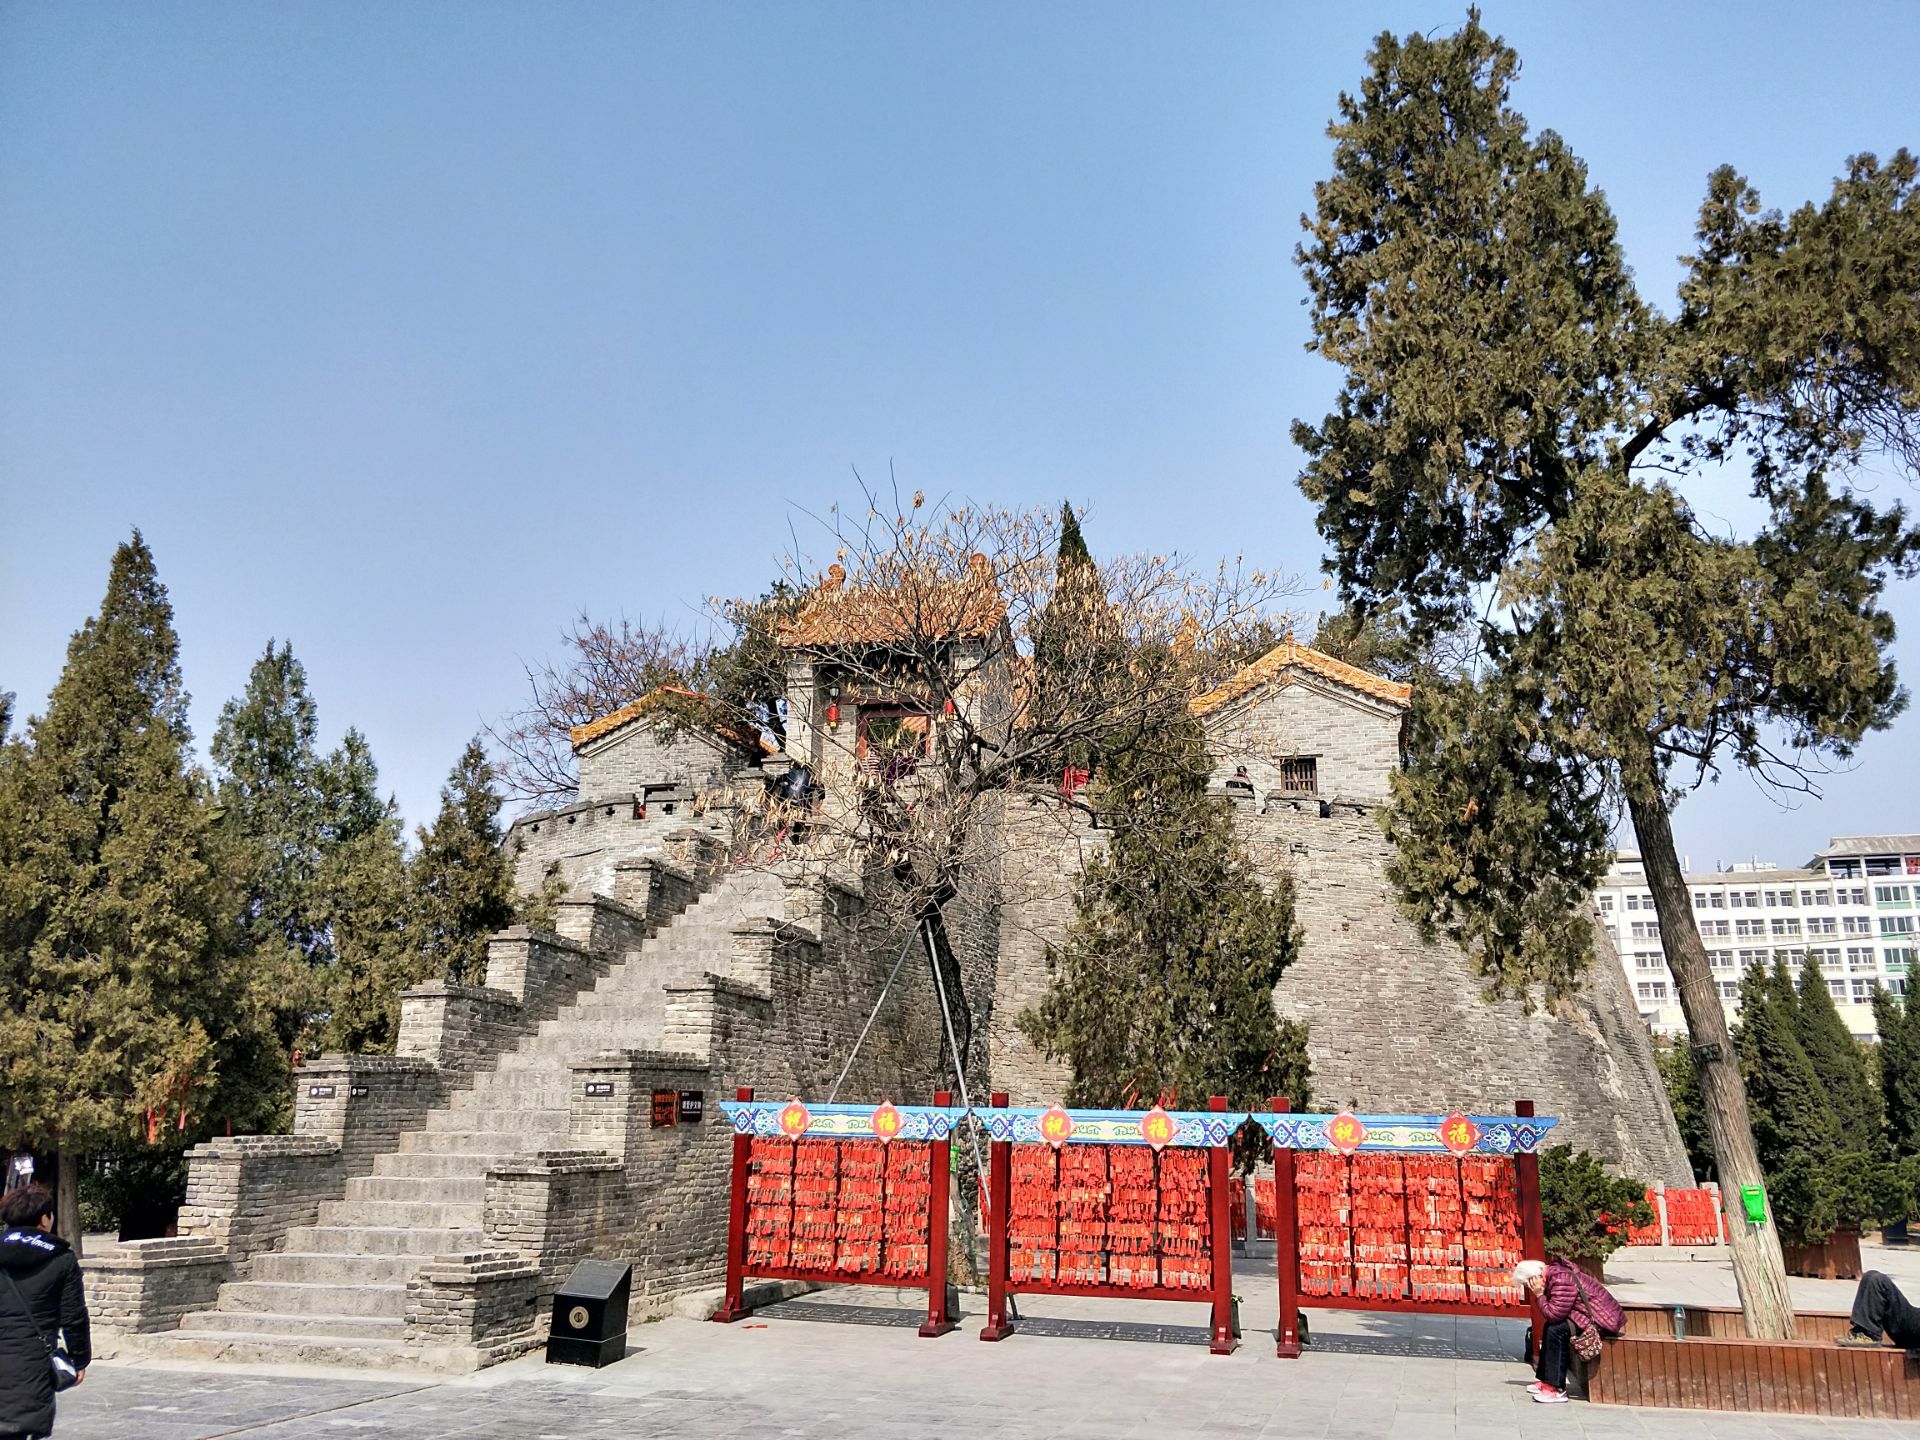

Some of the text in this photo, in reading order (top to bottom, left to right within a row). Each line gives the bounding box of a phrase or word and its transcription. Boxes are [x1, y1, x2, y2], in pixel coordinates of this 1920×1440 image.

[785, 1109, 897, 1132] 祝 福
[1045, 1115, 1169, 1139] 祝 福
[1333, 1120, 1471, 1146] 祝 福
